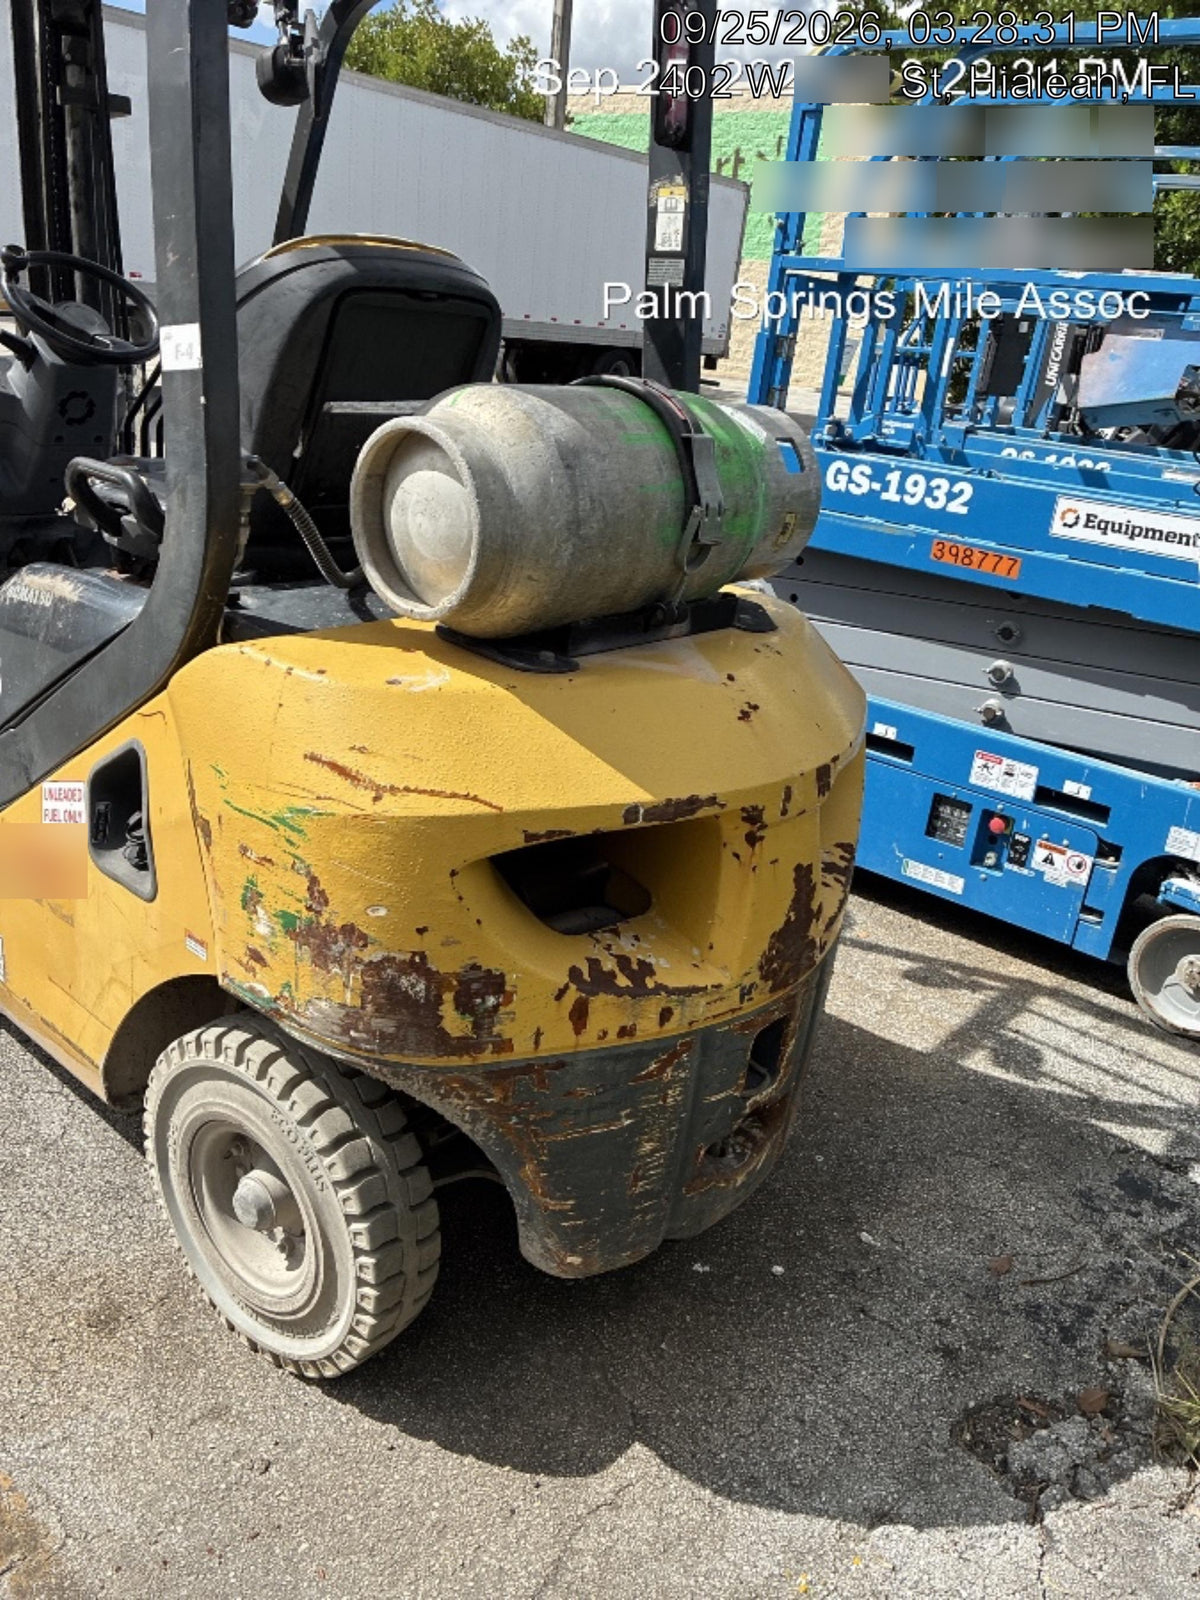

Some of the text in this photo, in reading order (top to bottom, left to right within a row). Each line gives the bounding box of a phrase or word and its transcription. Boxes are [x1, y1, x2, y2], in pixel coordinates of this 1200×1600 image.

[825, 460, 974, 515] GS-1932
[932, 541, 1019, 577] 398777
[44, 786, 83, 802] UNLEADED
[44, 808, 83, 824] FUEL ONLY
